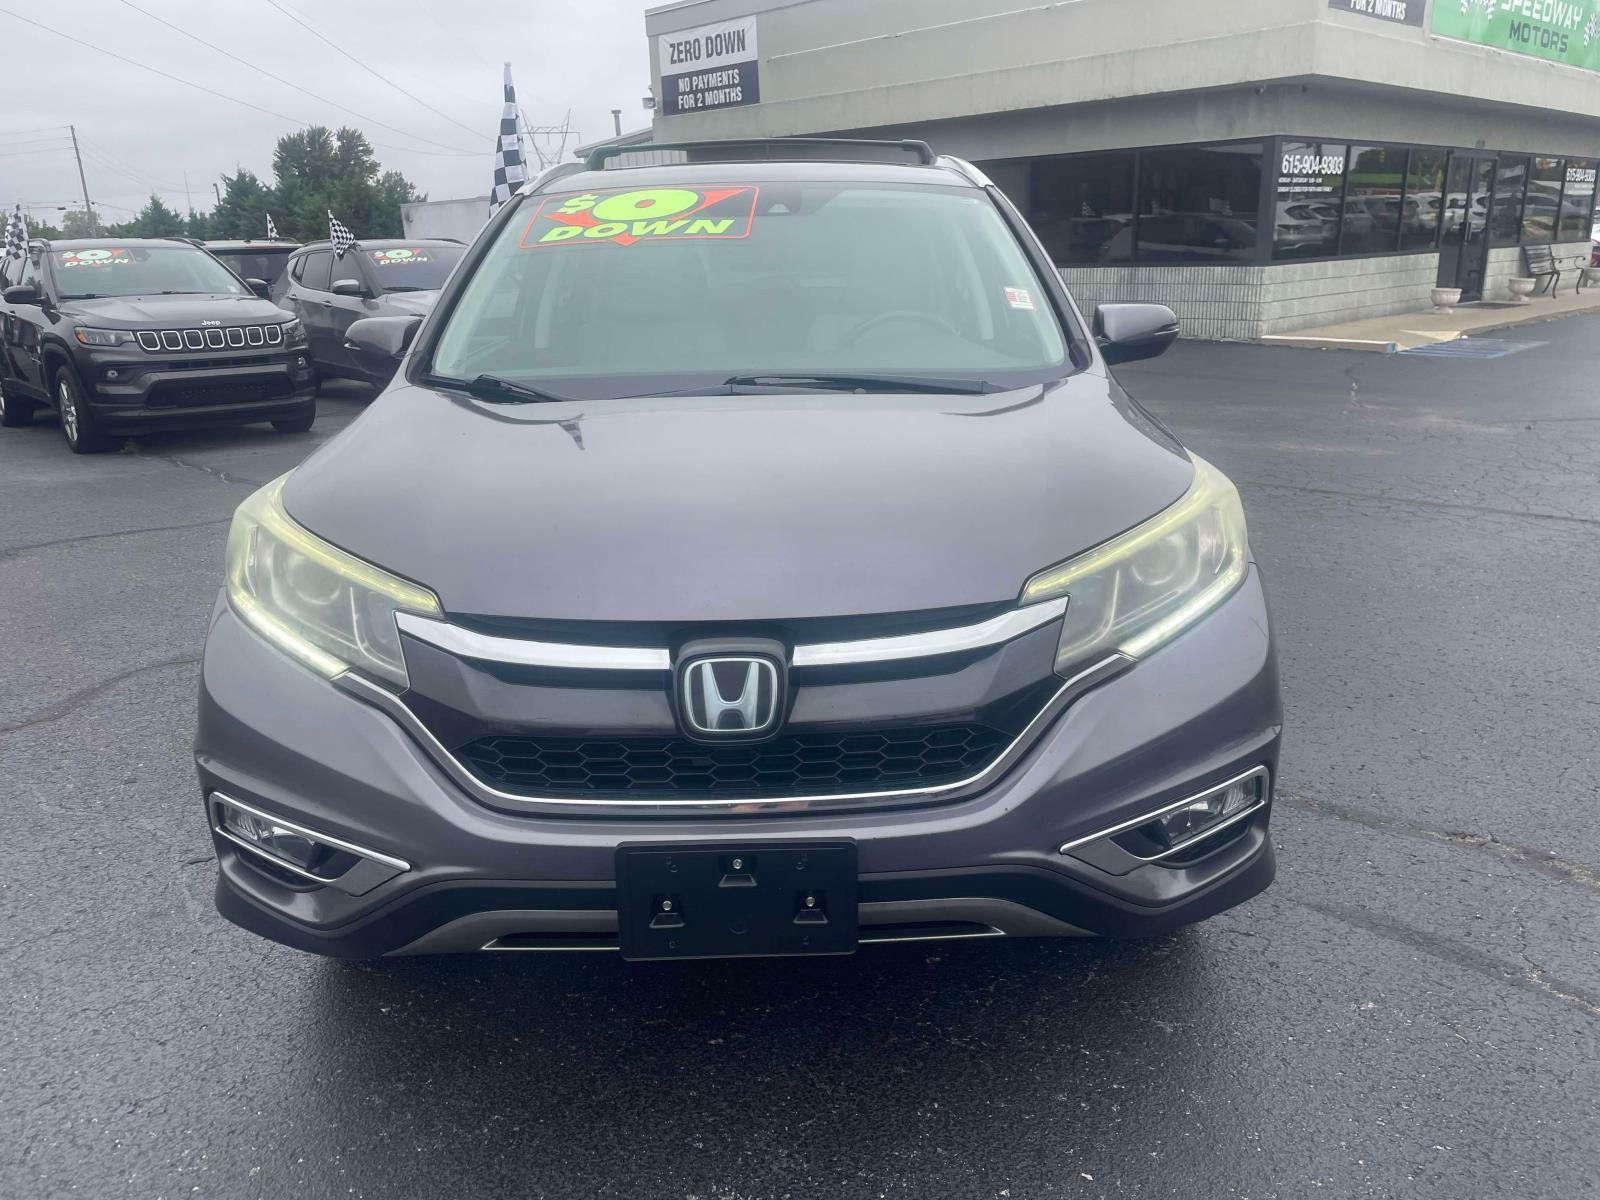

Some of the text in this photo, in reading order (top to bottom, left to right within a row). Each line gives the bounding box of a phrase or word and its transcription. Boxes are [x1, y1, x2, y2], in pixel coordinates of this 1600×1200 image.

[669, 29, 746, 65] ZERO DOWN
[1509, 20, 1569, 53] MOTORS
[678, 69, 740, 93] NO PAYMENTS
[678, 86, 742, 110] FOR 2 MONTHS
[551, 188, 699, 221] $0
[538, 219, 736, 243] DOWN
[64, 258, 129, 268] DOWN
[380, 257, 428, 265] DOWN
[201, 319, 221, 327] Jeep
